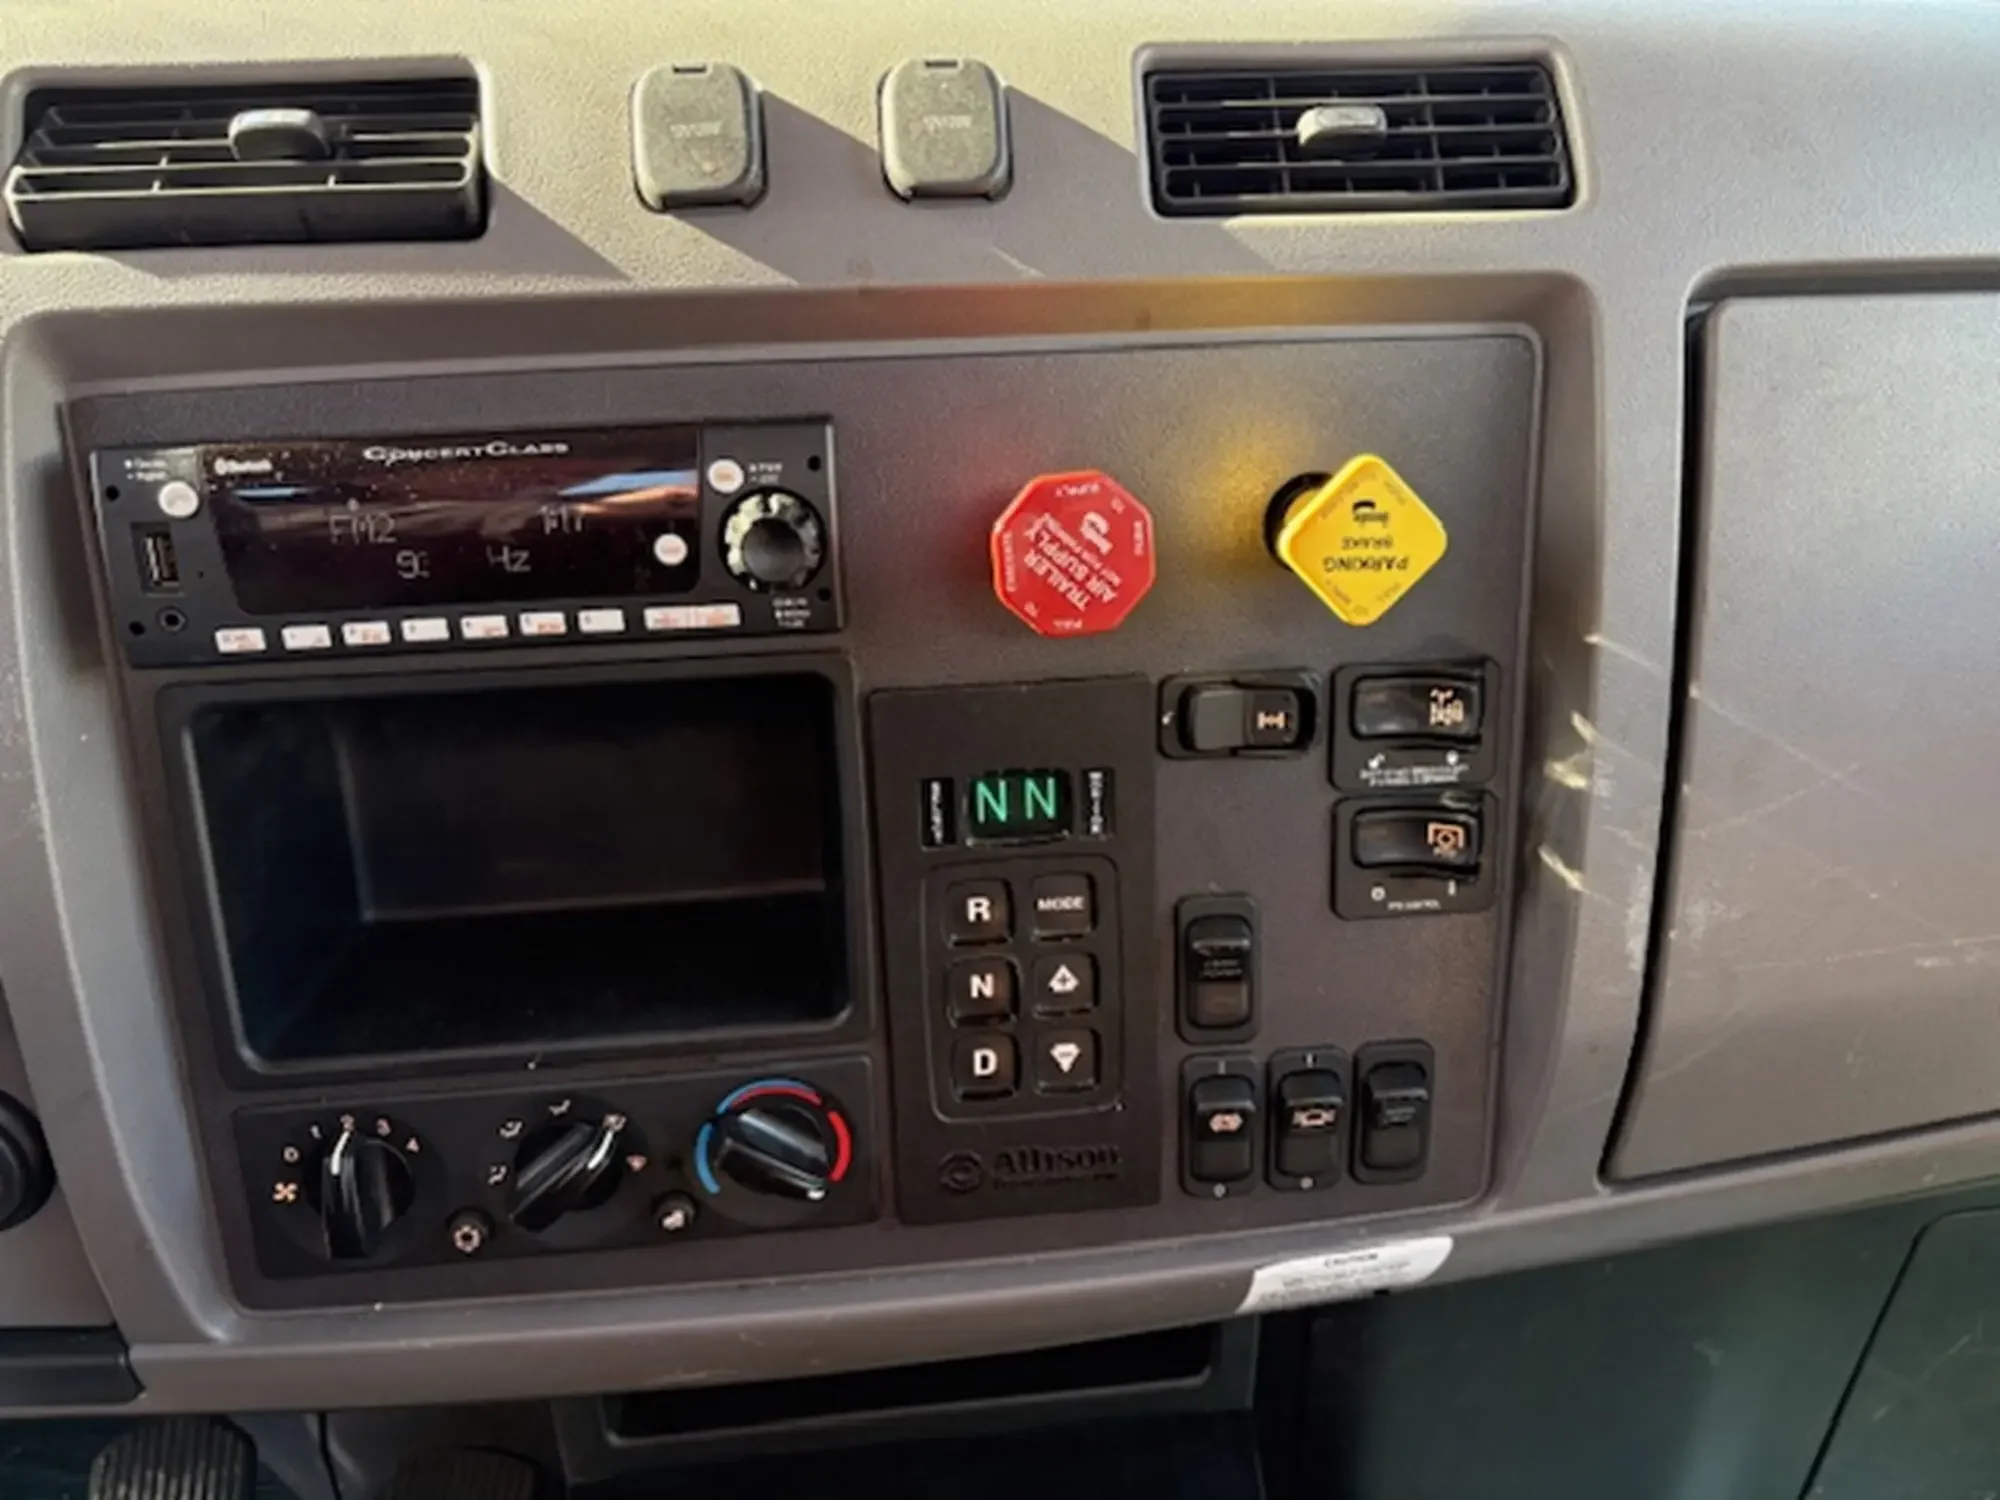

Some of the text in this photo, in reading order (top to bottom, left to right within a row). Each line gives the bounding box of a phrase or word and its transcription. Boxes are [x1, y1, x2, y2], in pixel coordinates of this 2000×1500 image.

[1024, 519, 1089, 582] SUPPLY
[1322, 555, 1410, 573] PARKING
[1023, 549, 1092, 612] TRAILER
[1085, 574, 1118, 604] AIR
[976, 781, 1007, 824] N
[1025, 777, 1056, 820] N
[966, 896, 991, 922] R
[1037, 896, 1085, 911] MODE
[969, 973, 995, 999] N
[972, 1047, 998, 1077] D
